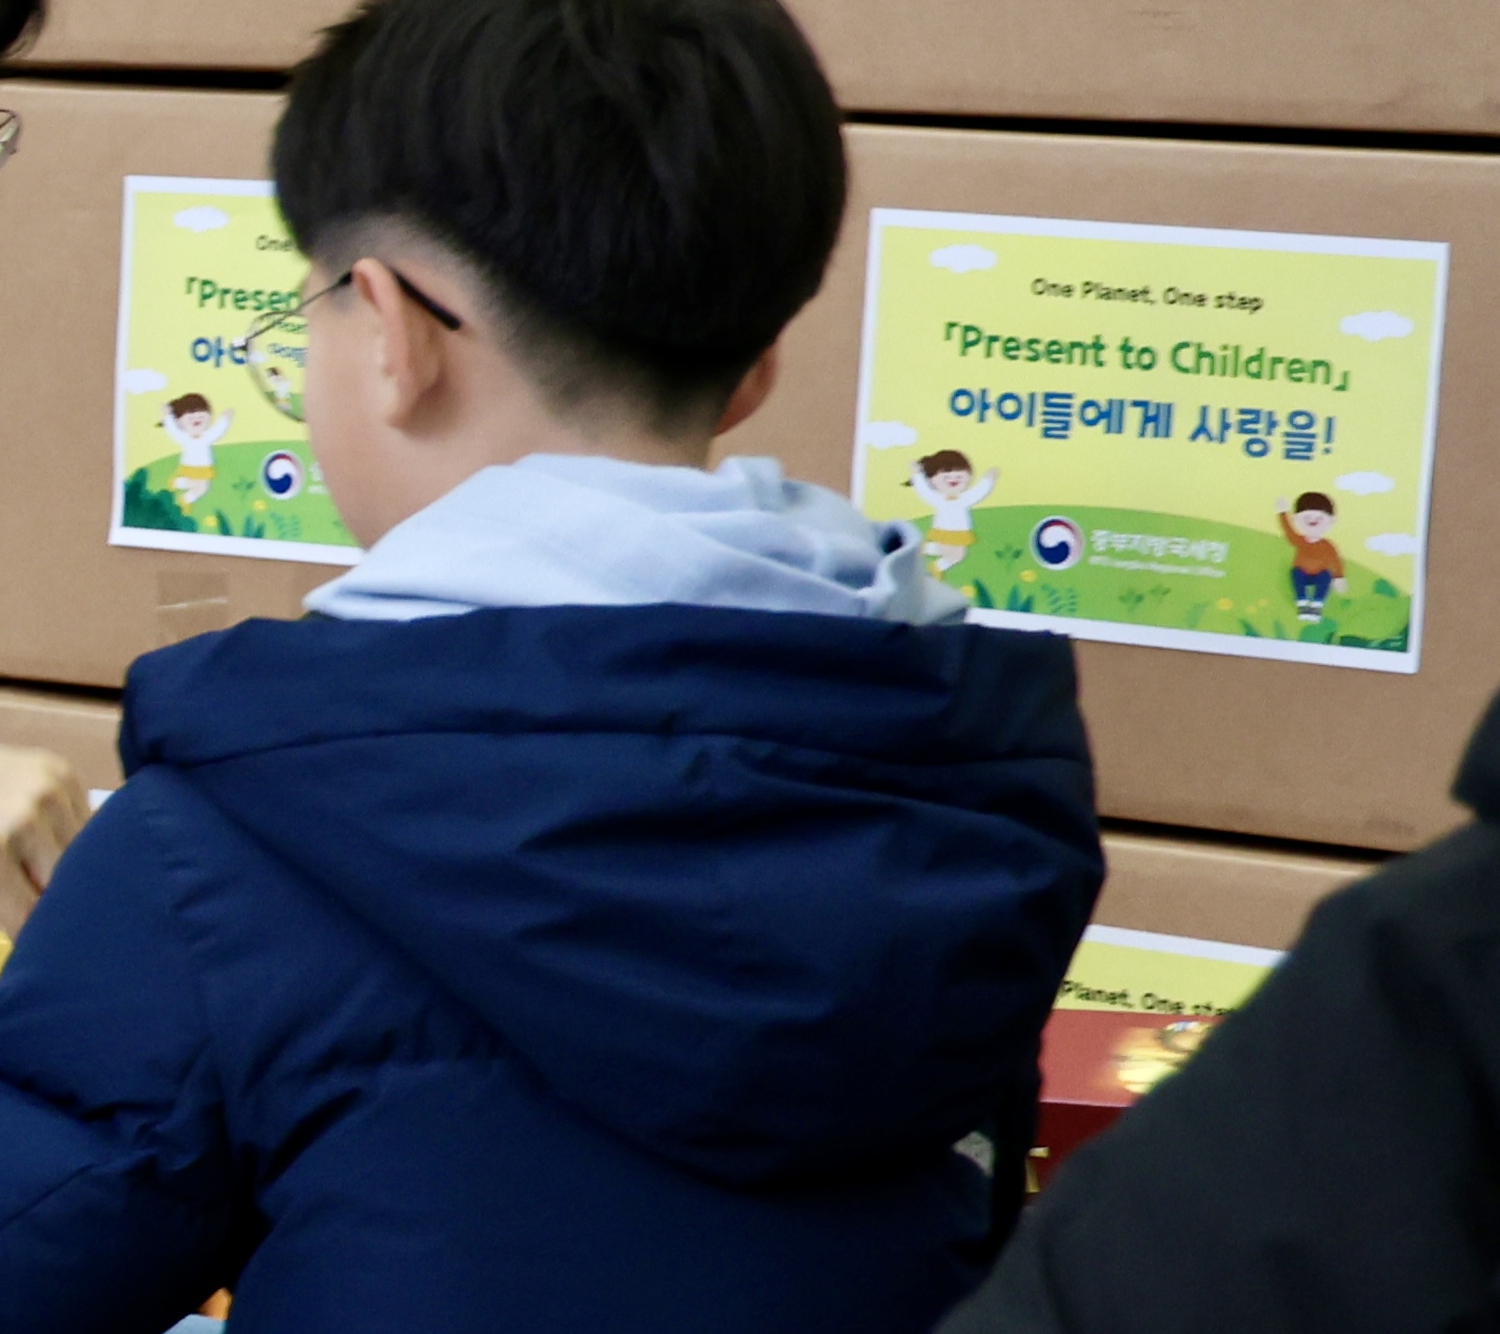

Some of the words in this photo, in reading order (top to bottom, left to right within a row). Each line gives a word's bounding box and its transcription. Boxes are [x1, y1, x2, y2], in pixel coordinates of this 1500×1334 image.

[1031, 278, 1076, 300] One
[1082, 281, 1156, 307] Planet,
[1163, 286, 1207, 308] One
[1213, 290, 1265, 315] step
[1119, 337, 1156, 372] to
[948, 387, 1173, 440] 아이들에게
[1190, 404, 1337, 461] 사랑을!
